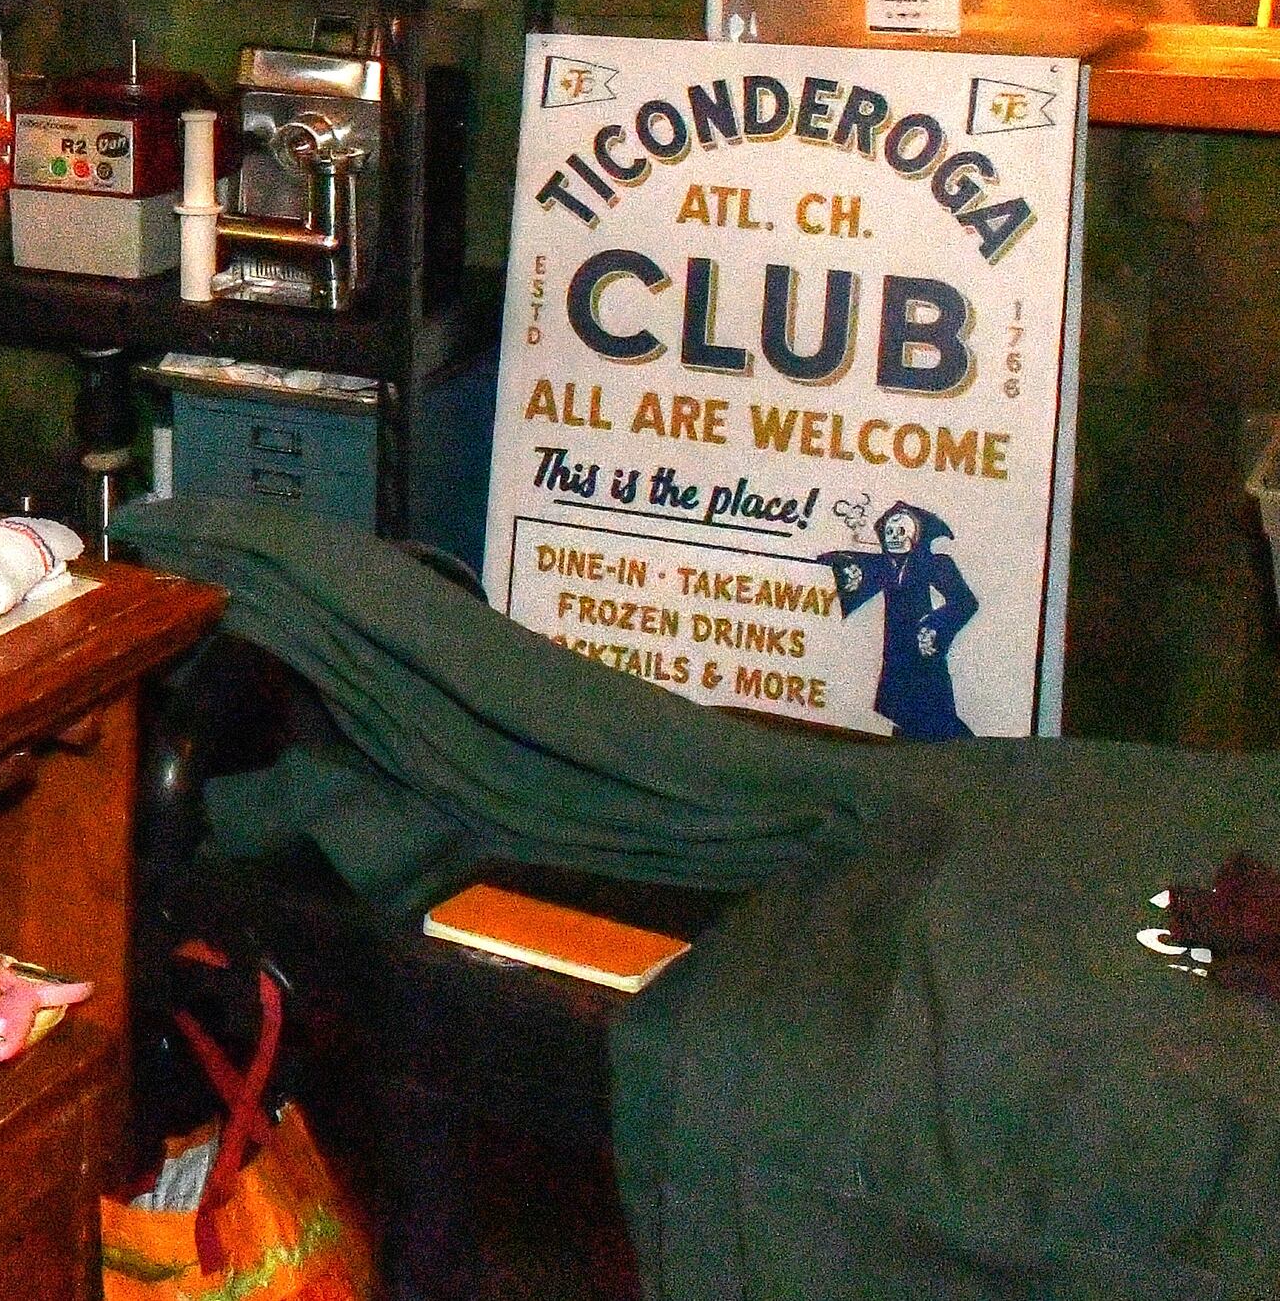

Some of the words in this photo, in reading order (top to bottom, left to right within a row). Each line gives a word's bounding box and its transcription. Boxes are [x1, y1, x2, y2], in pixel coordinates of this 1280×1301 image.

[61, 138, 88, 155] R2
[535, 74, 1038, 266] TICONDEROGA
[676, 183, 774, 231] ATL.
[795, 192, 873, 239] CH.
[566, 248, 978, 399] CLUB
[1005, 299, 1025, 399] 1766
[524, 379, 612, 431] ALL
[631, 392, 729, 445] ARE
[750, 404, 1011, 480] WELCOME
[534, 446, 600, 499] This
[610, 469, 640, 504] is
[649, 467, 700, 511] the
[704, 477, 820, 530] place!
[536, 544, 647, 588] DINE-IN
[677, 567, 838, 618] TAKEAWAY
[557, 592, 679, 637] FROZEN
[691, 613, 806, 659] DRINKS
[701, 661, 723, 690] &
[735, 665, 828, 708] MORE
